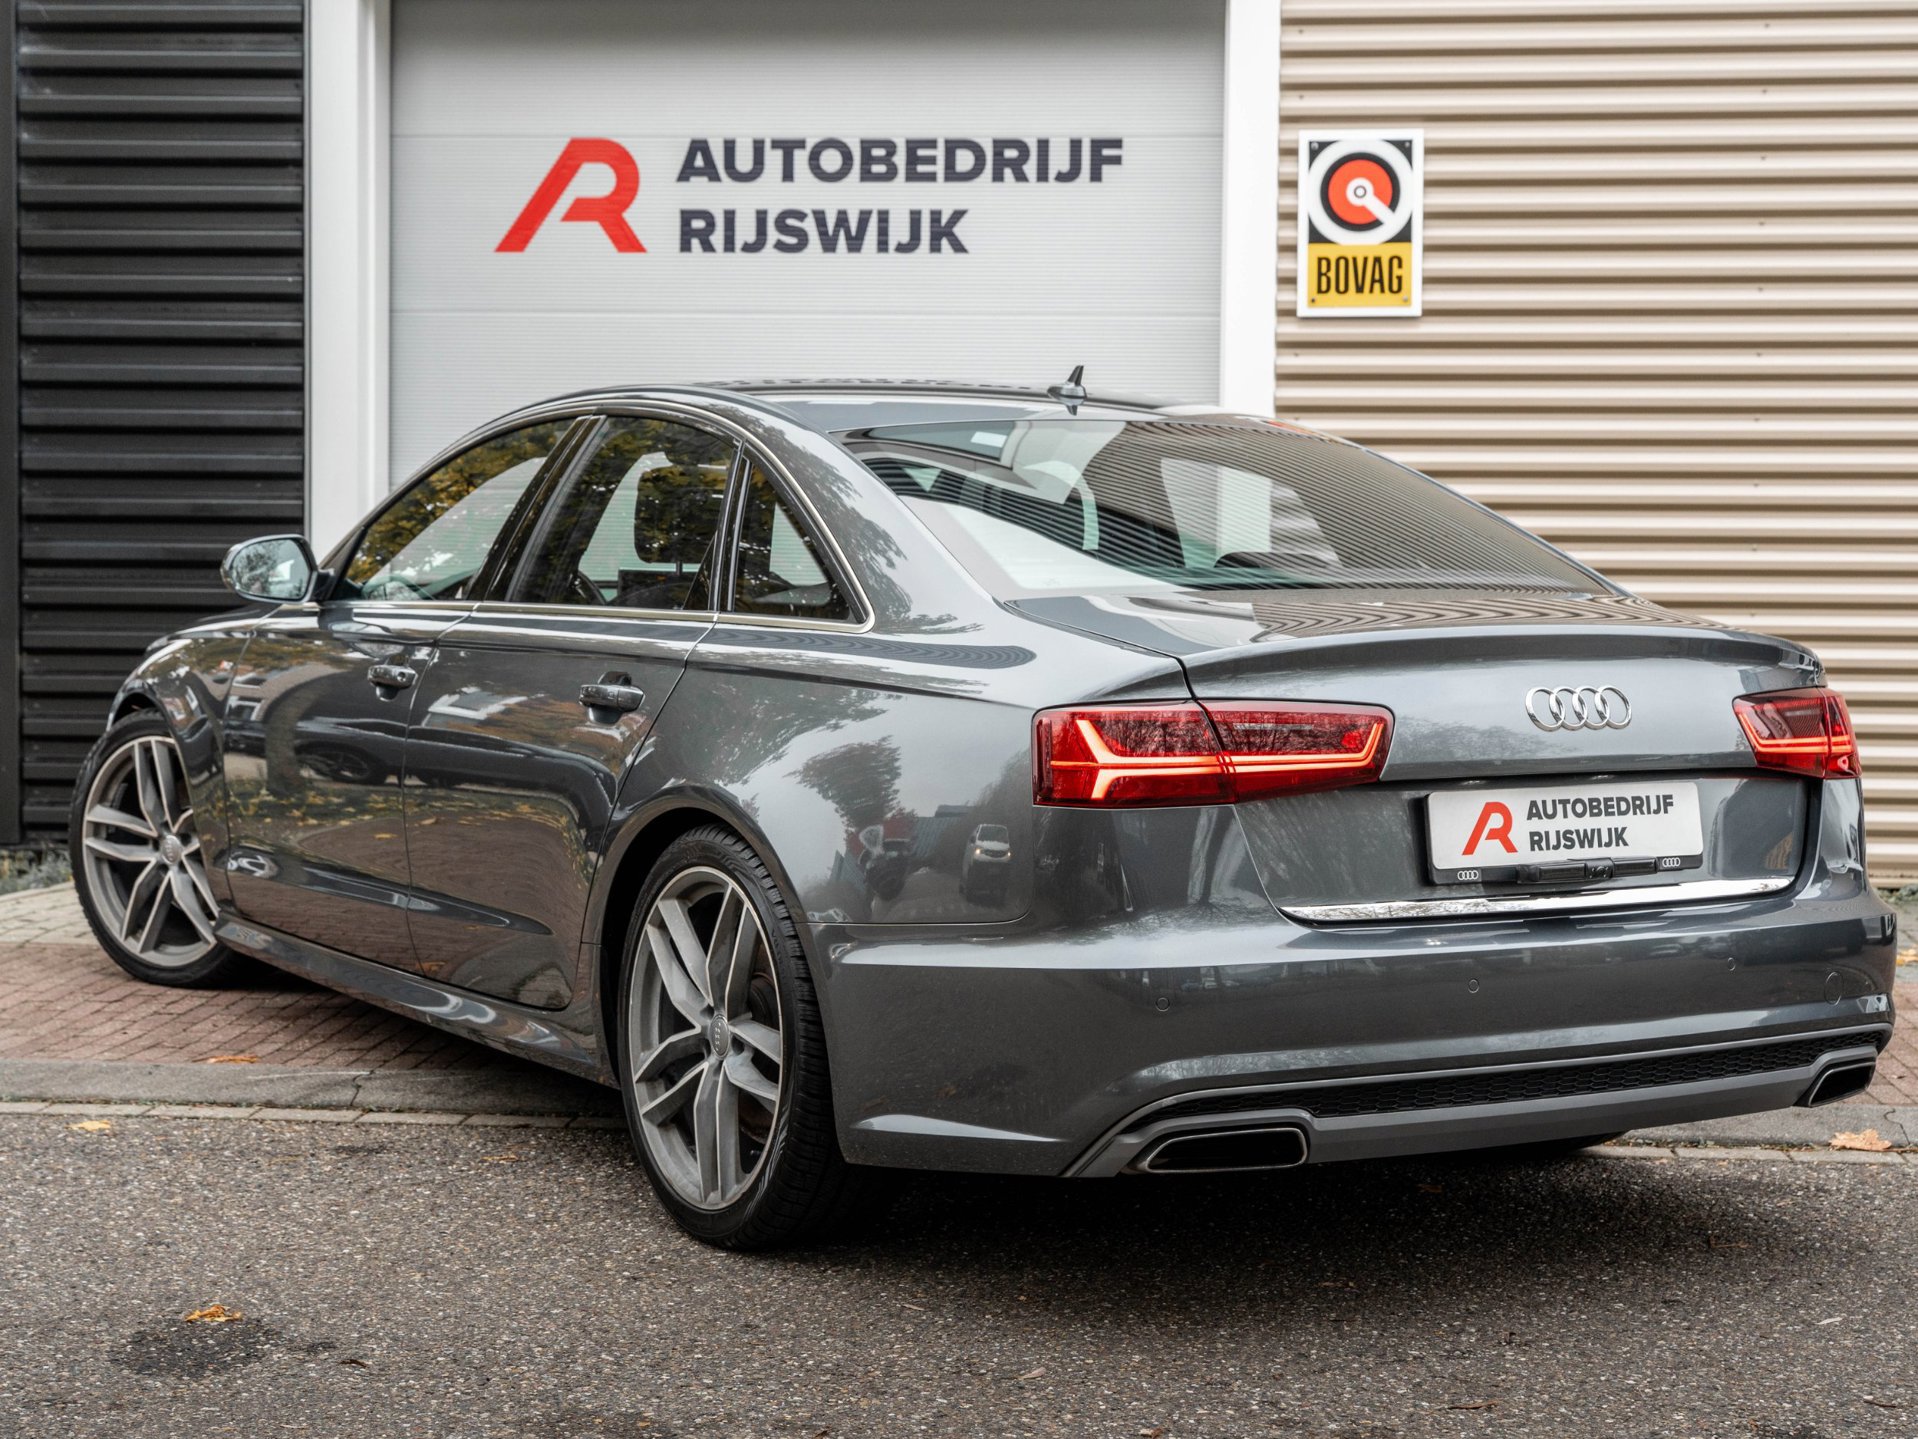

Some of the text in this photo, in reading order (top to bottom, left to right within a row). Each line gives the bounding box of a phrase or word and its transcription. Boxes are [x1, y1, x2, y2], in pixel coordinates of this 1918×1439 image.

[677, 137, 1122, 183] AUTOBEDRIJF
[680, 209, 969, 254] RIJSWIJK
[1316, 255, 1403, 295] BOVAG
[1526, 794, 1674, 821] AUTOBEDRIJF
[1529, 826, 1629, 852] RIJSWIJK
